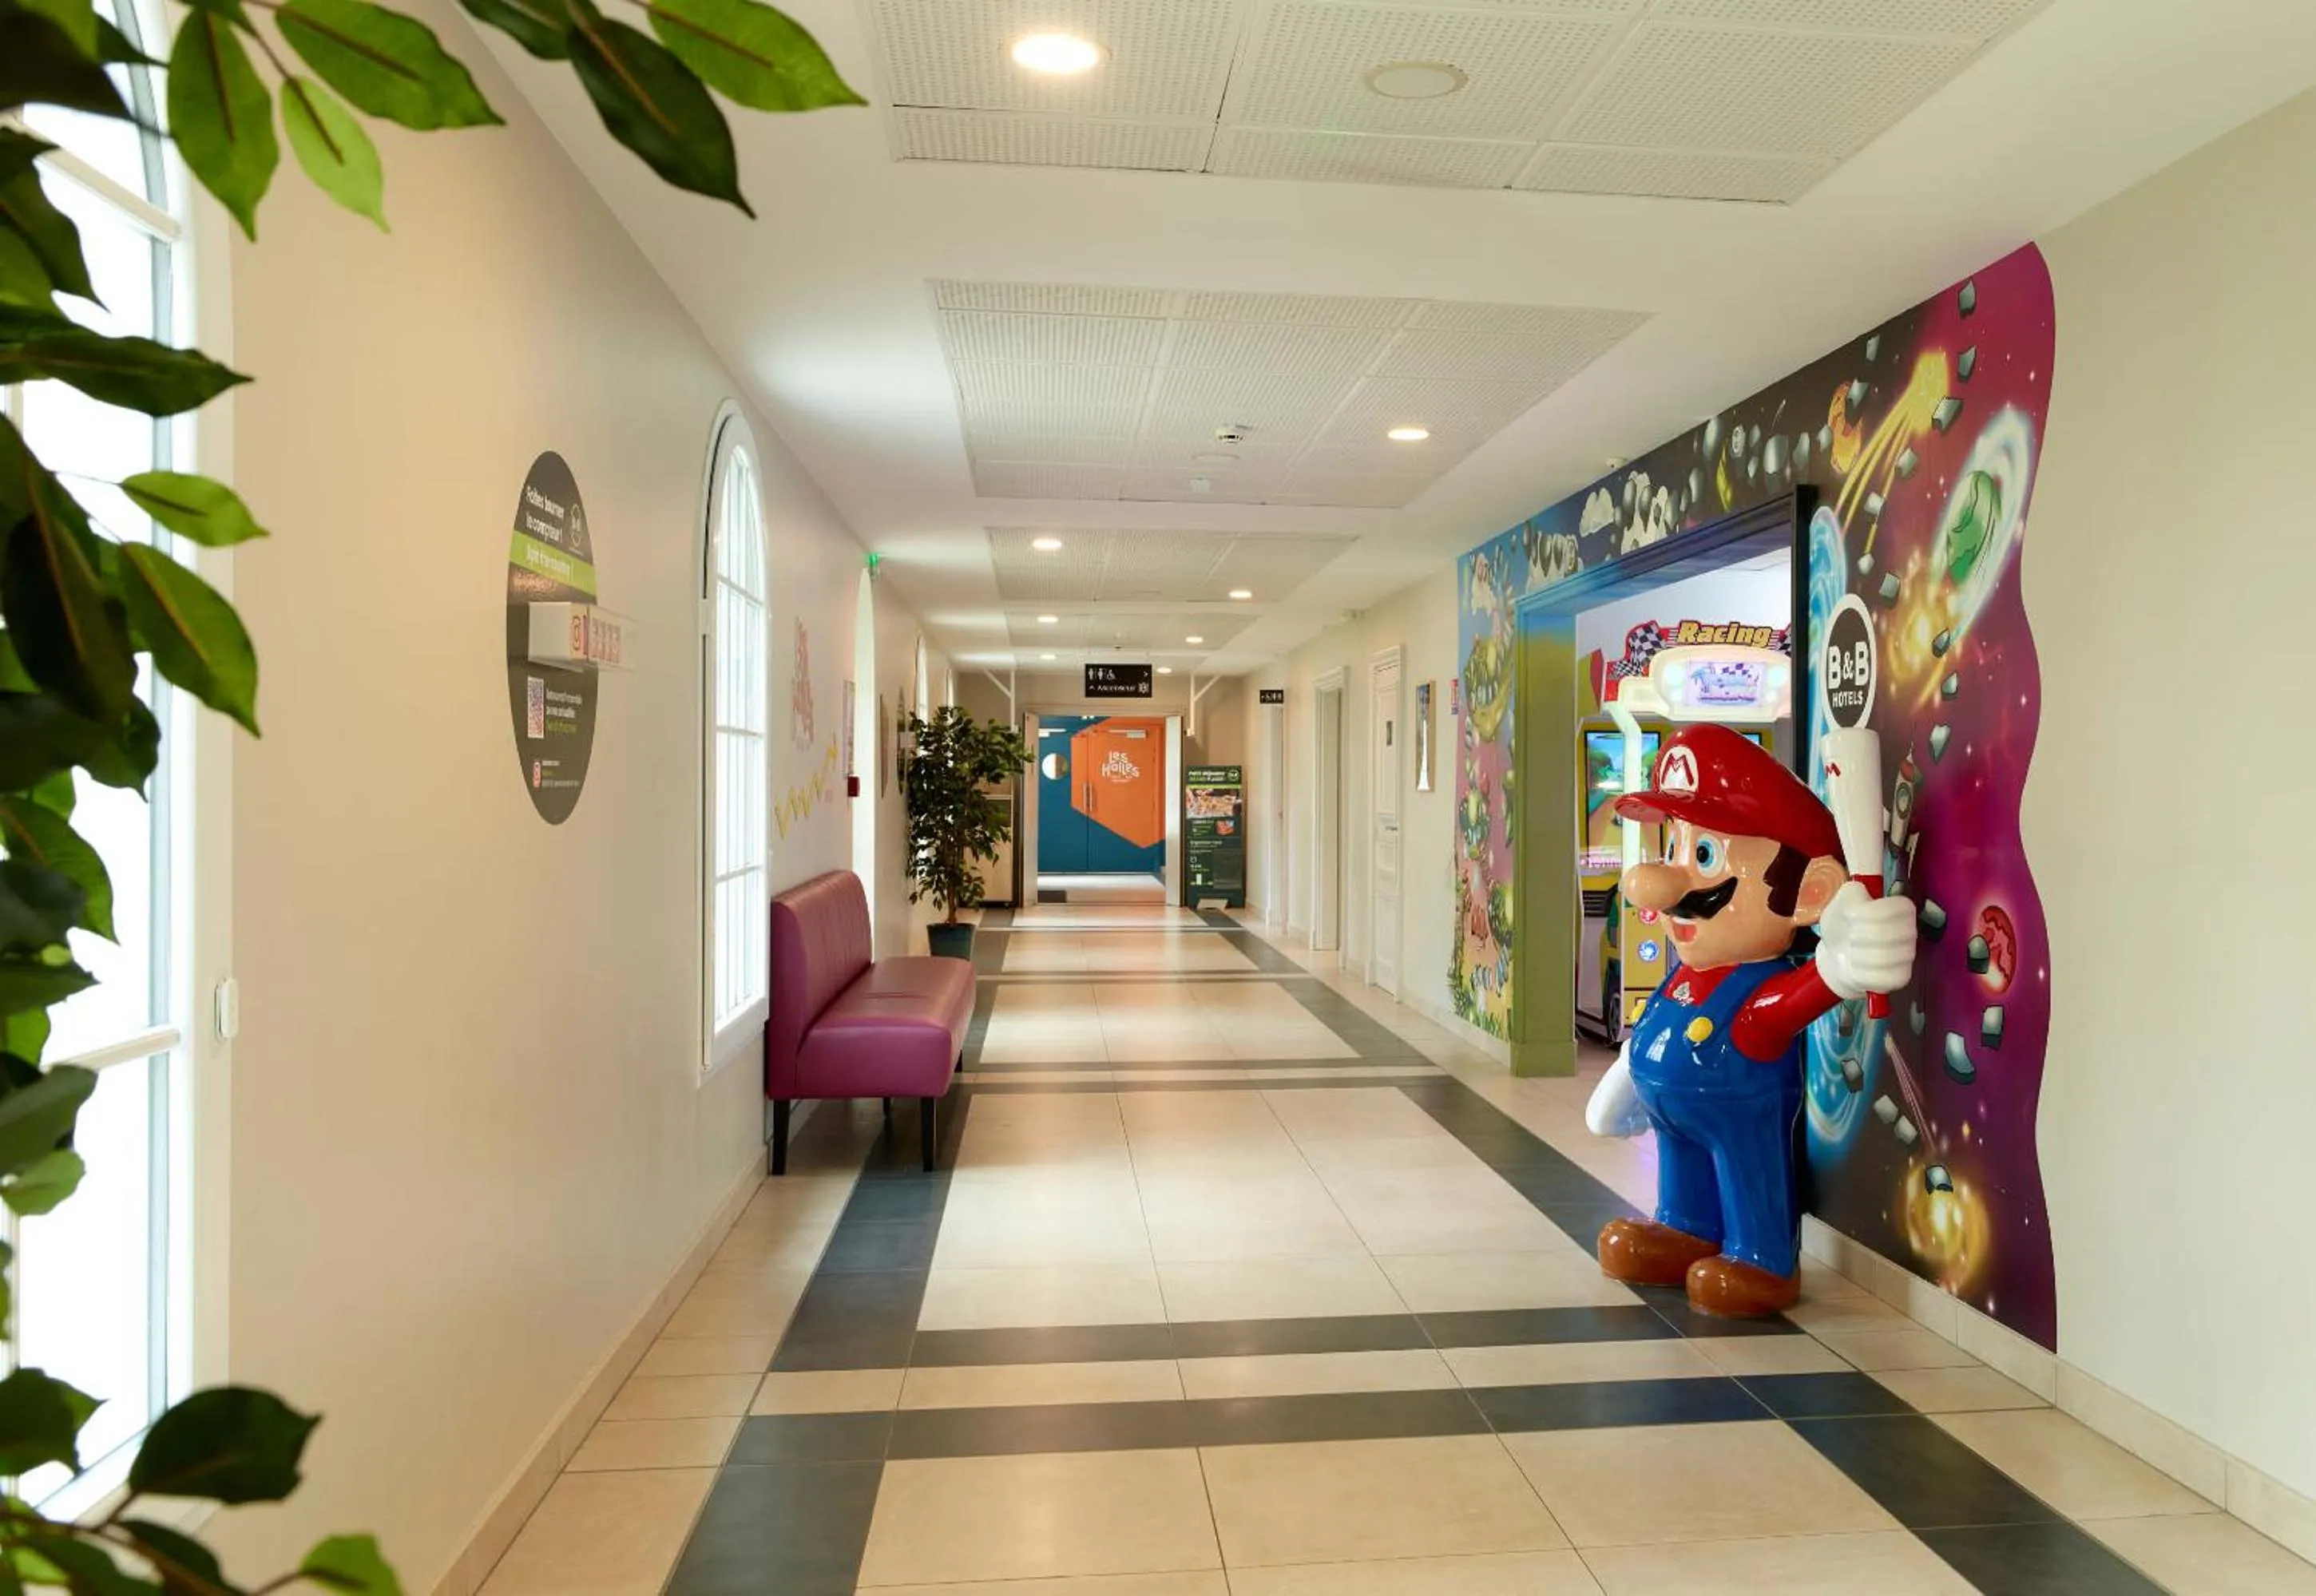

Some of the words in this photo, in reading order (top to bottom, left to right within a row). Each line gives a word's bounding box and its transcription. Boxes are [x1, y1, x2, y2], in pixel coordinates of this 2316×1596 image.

[1677, 620, 1773, 648] Racing
[1829, 642, 1869, 689] B&B
[1832, 691, 1863, 707] HOTELS
[1660, 752, 1695, 786] M
